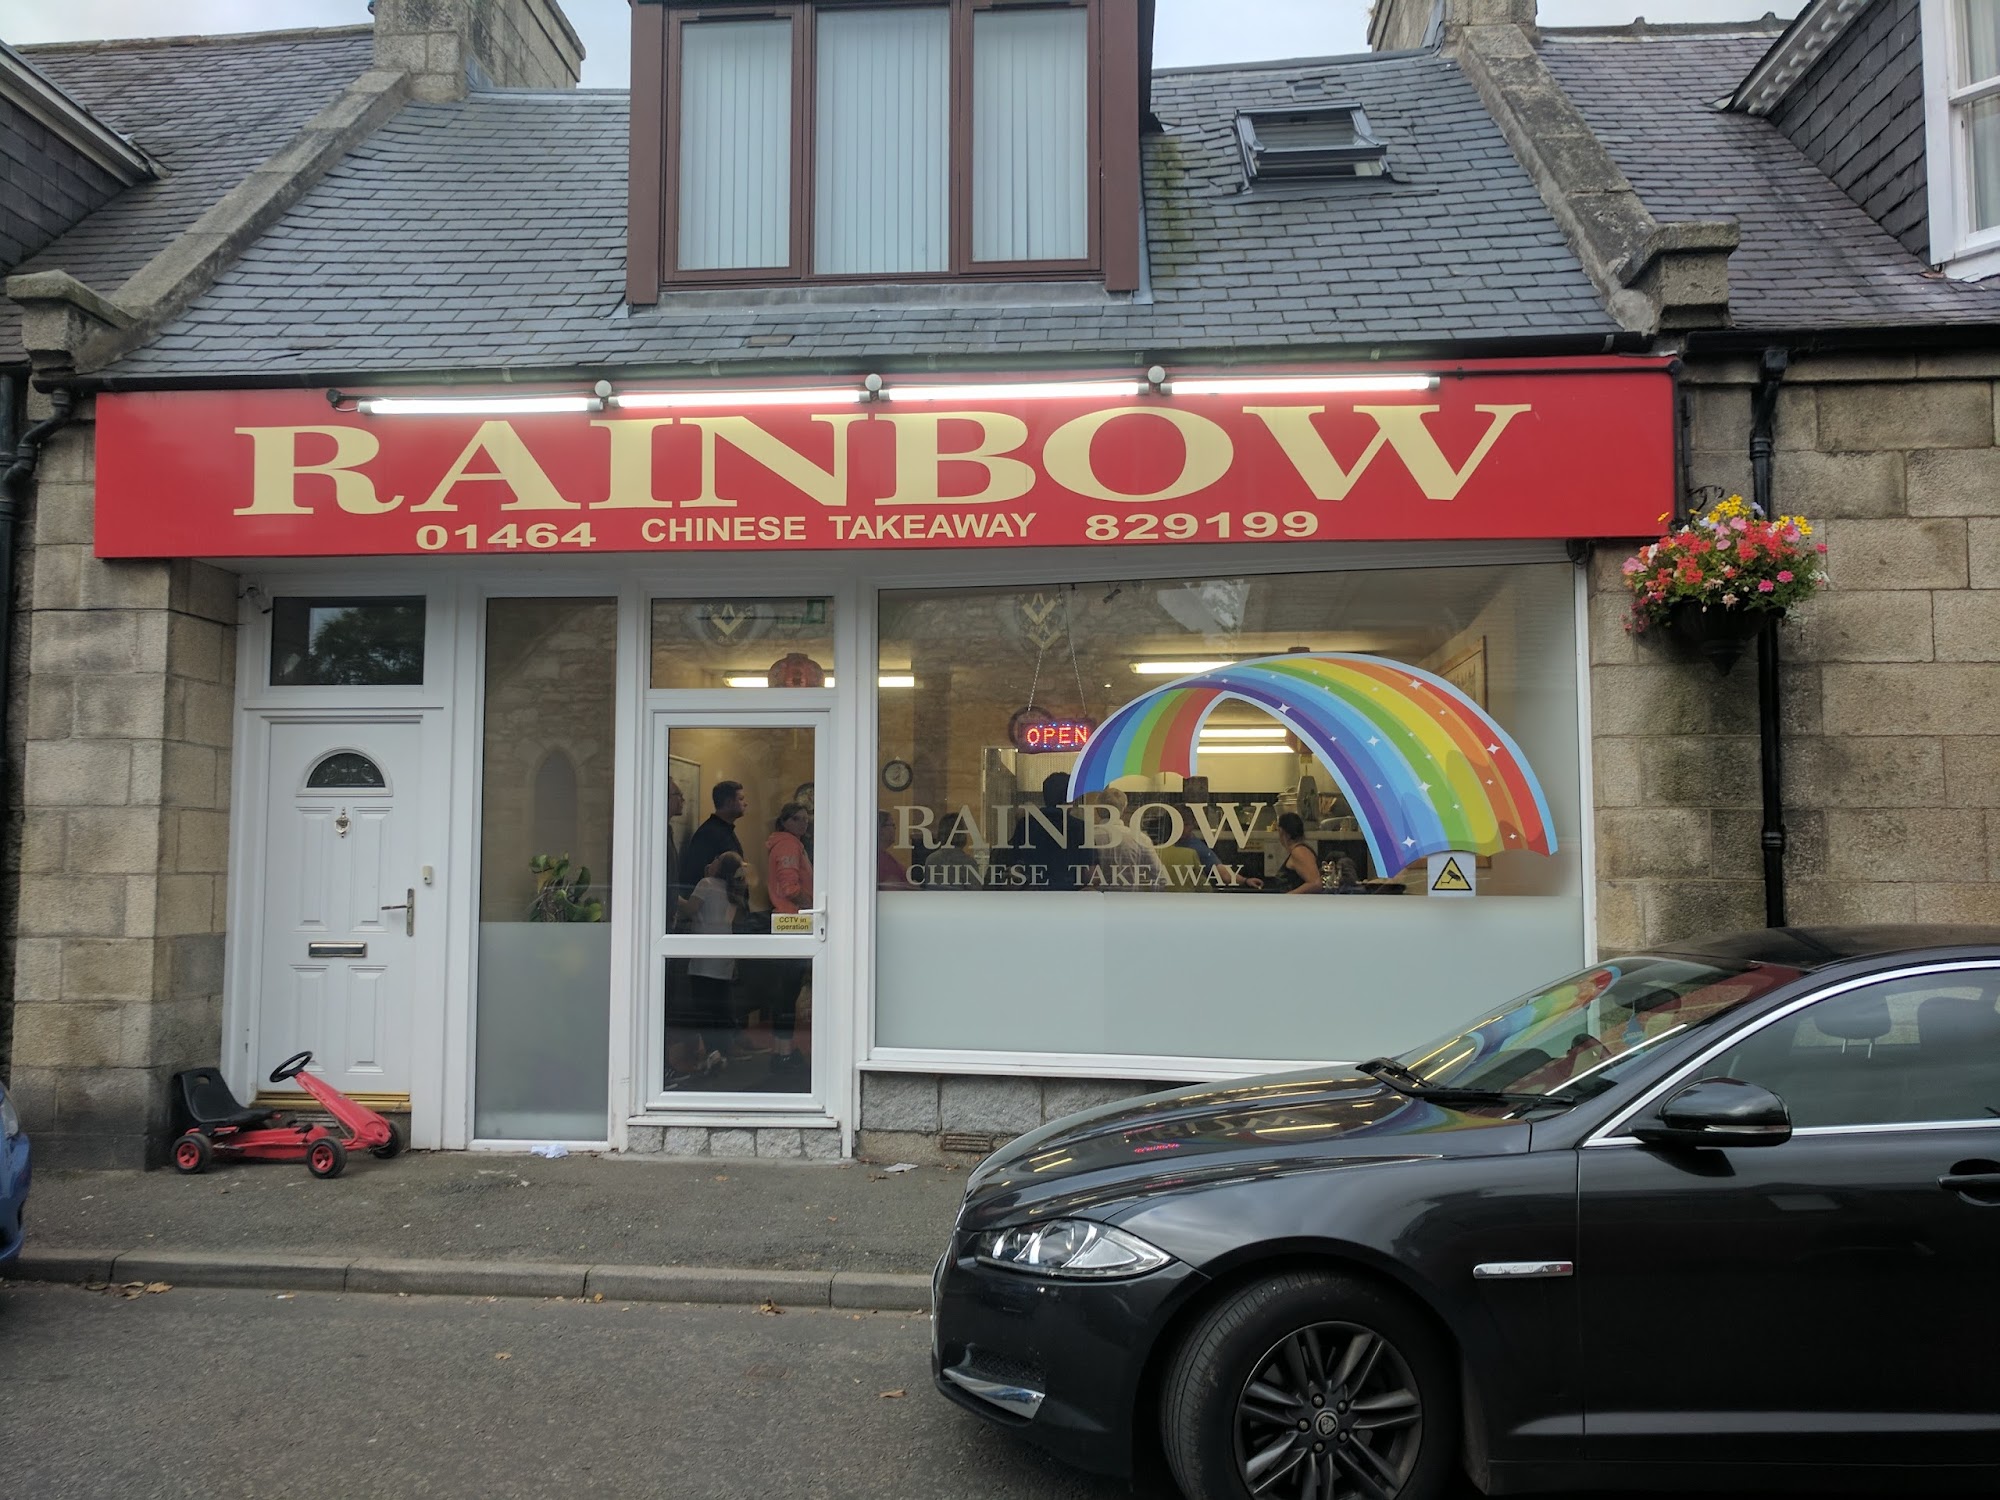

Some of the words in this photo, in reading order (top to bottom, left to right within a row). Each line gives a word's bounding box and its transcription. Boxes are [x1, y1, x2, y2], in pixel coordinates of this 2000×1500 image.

[233, 403, 1532, 516] RAINBOW
[416, 522, 597, 550] 01464
[641, 516, 807, 543] CHINESE
[828, 512, 1037, 541] TAKEAWAY
[1085, 510, 1319, 541] 829199
[1026, 726, 1087, 745] OPEN
[893, 802, 1267, 850] RAINBOW
[905, 864, 1050, 886] CHINESE
[1068, 864, 1244, 887] TAKEAWAY
